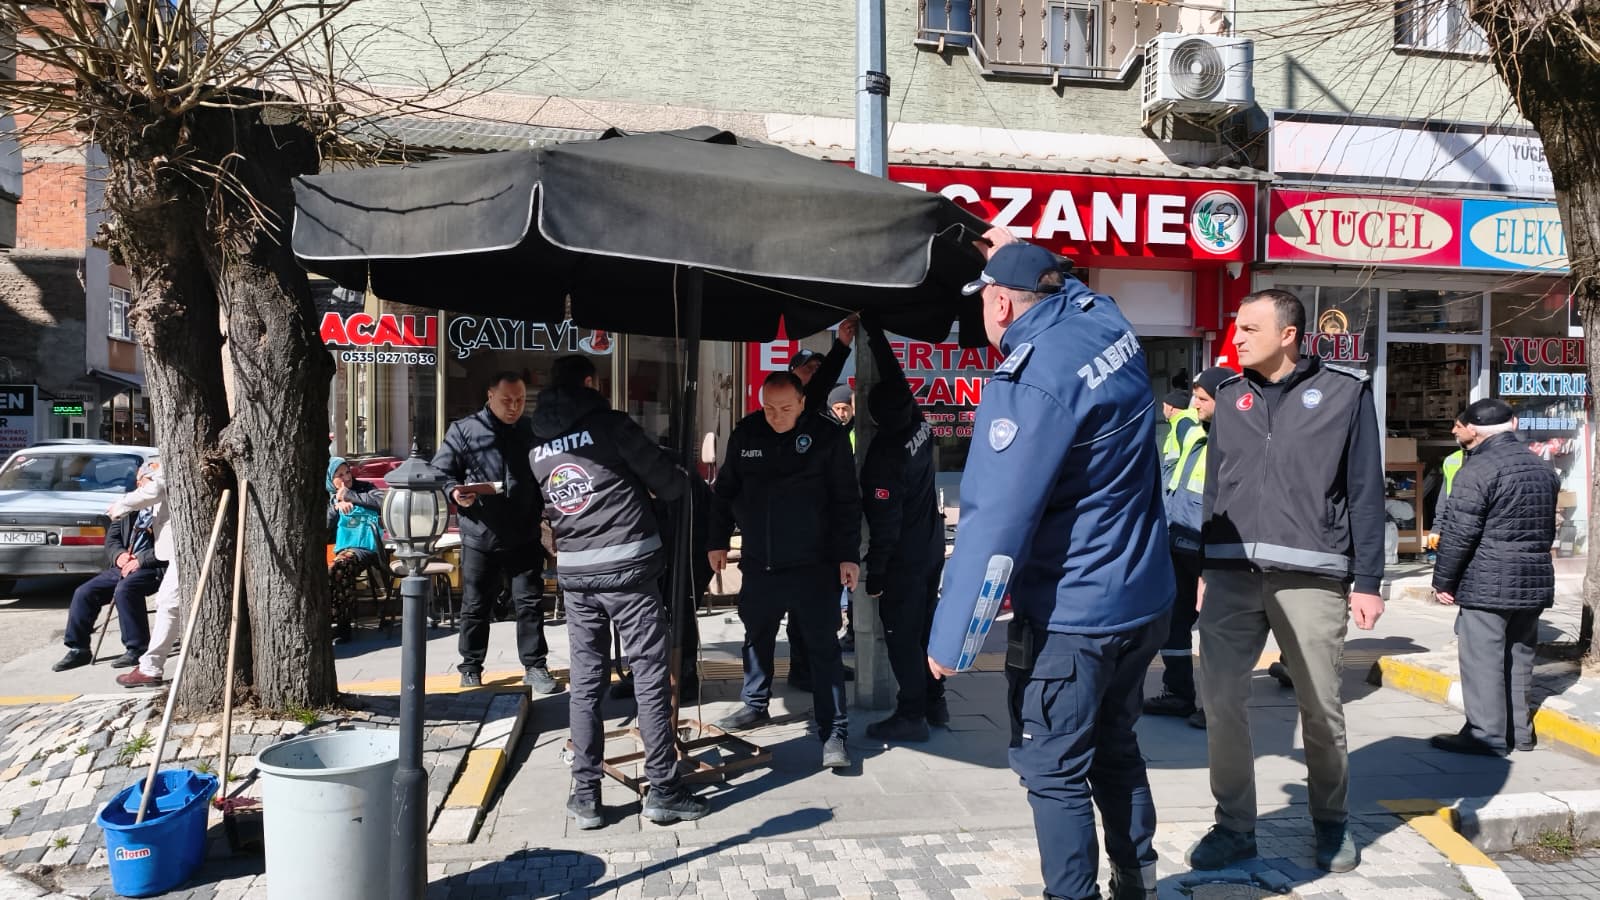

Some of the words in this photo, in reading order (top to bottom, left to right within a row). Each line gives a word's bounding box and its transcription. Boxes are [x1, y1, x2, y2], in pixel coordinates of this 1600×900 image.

[897, 182, 1186, 245] ZANE
[1300, 209, 1433, 249] YÜCEL
[342, 352, 374, 363] 0535
[377, 353, 400, 363] 927
[403, 354, 417, 364] 16
[419, 354, 436, 364] 30
[1077, 330, 1141, 390] ZABITA
[534, 430, 594, 462] ZABITA
[23, 532, 43, 541] 705
